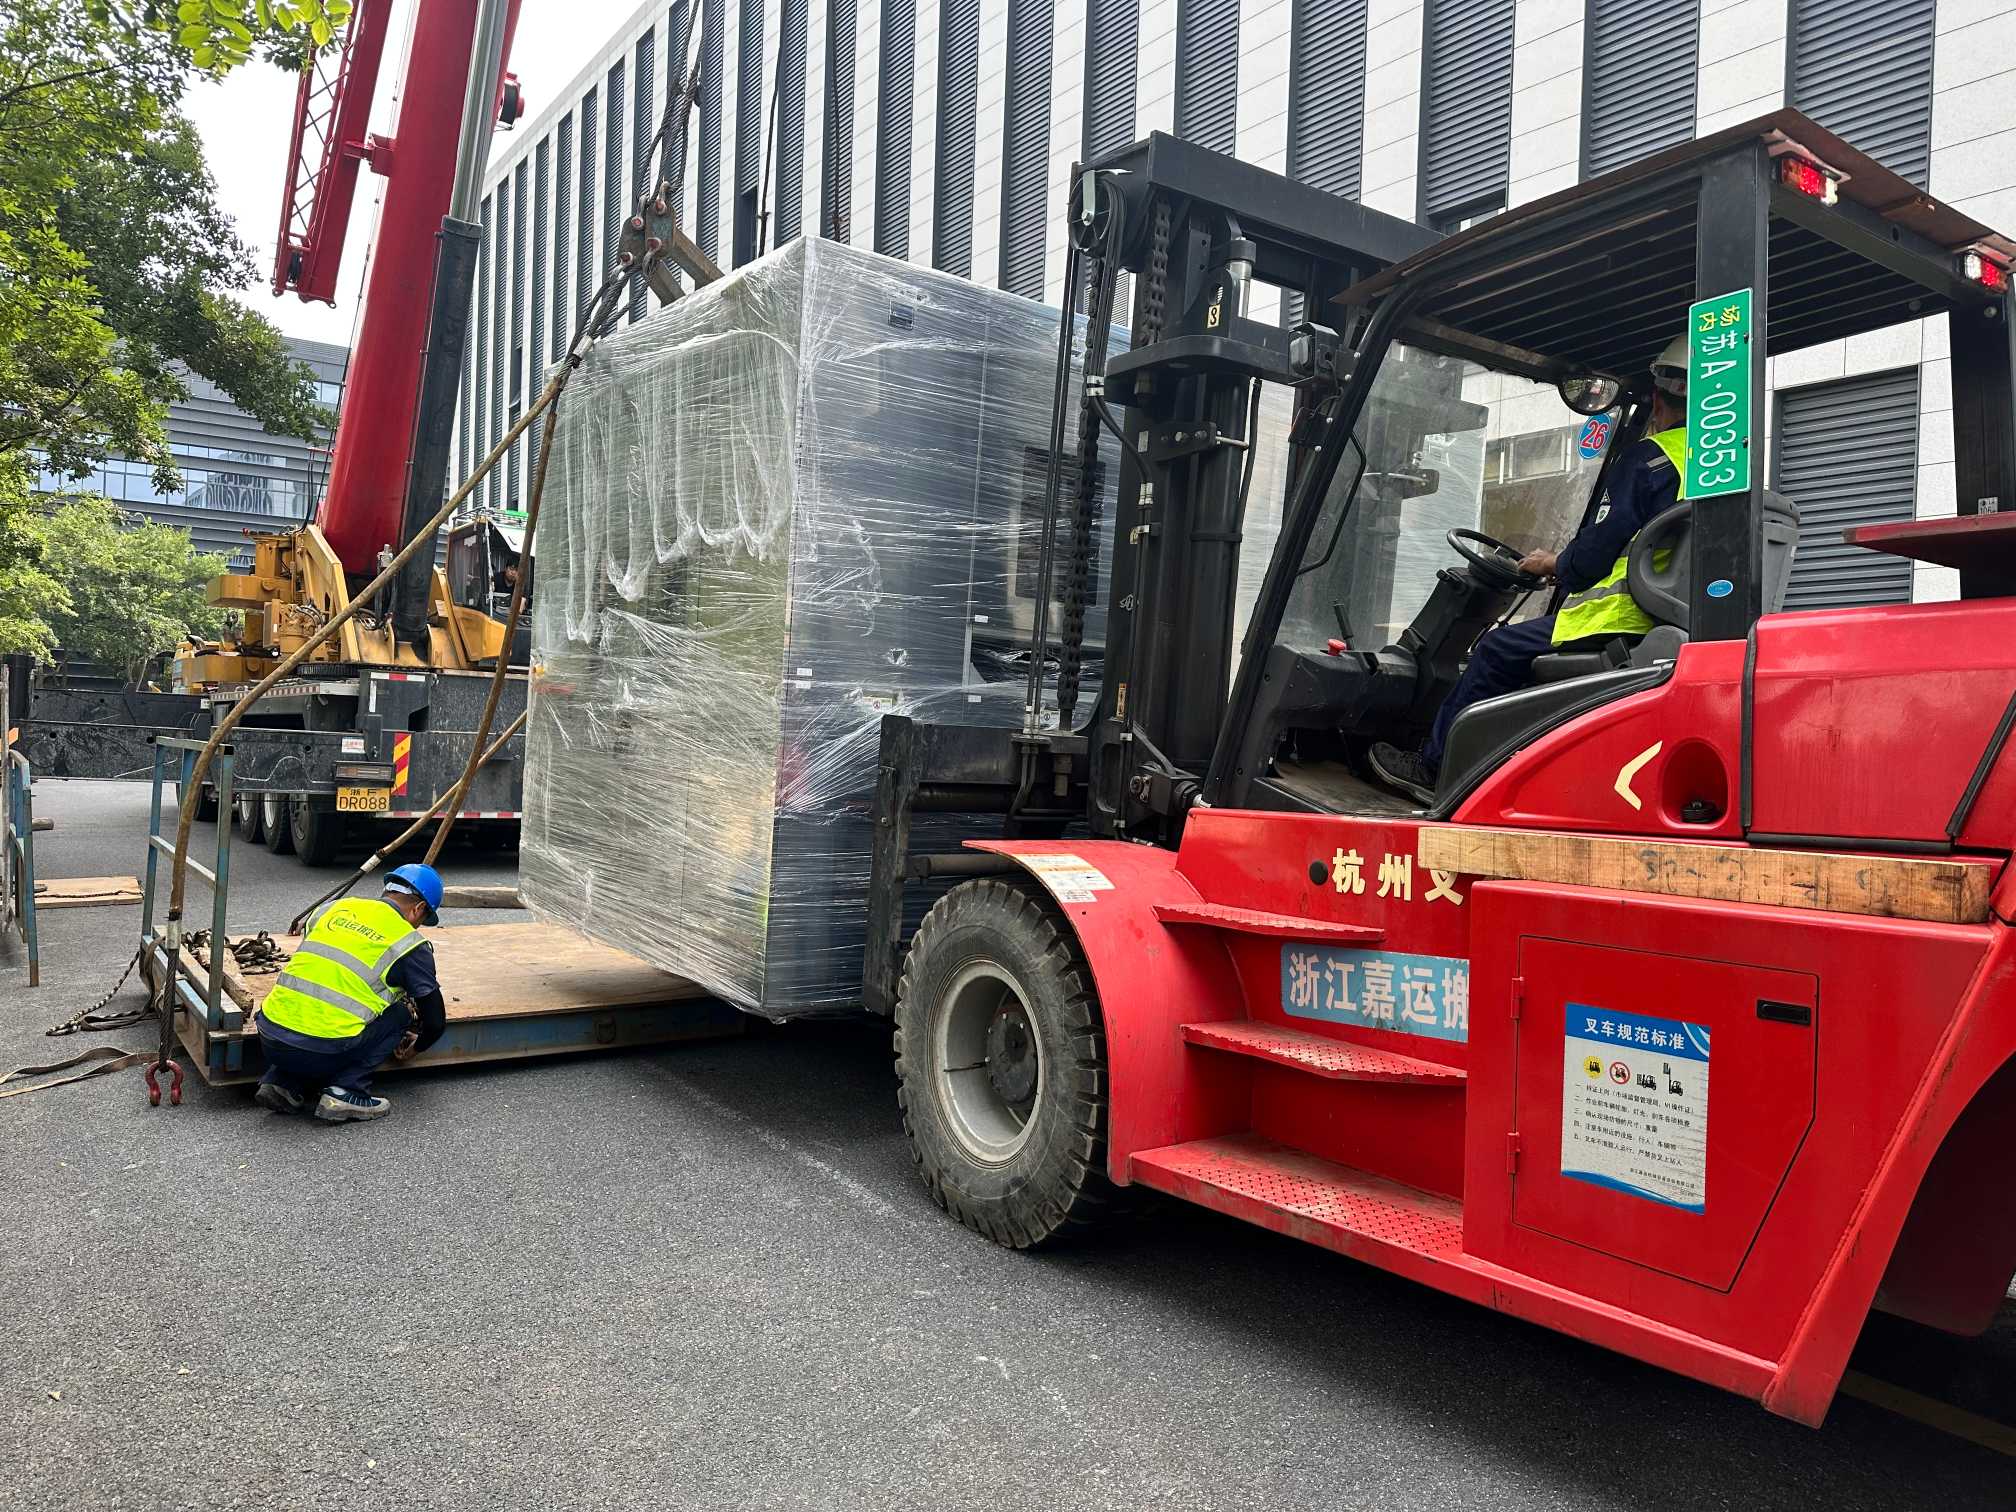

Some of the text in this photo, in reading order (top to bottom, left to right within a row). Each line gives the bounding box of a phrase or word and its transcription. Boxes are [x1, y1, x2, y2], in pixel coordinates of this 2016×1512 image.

[1579, 420, 1608, 450] 26
[339, 797, 387, 810] DR088
[1584, 1017, 1685, 1050] 叉车规范标准
